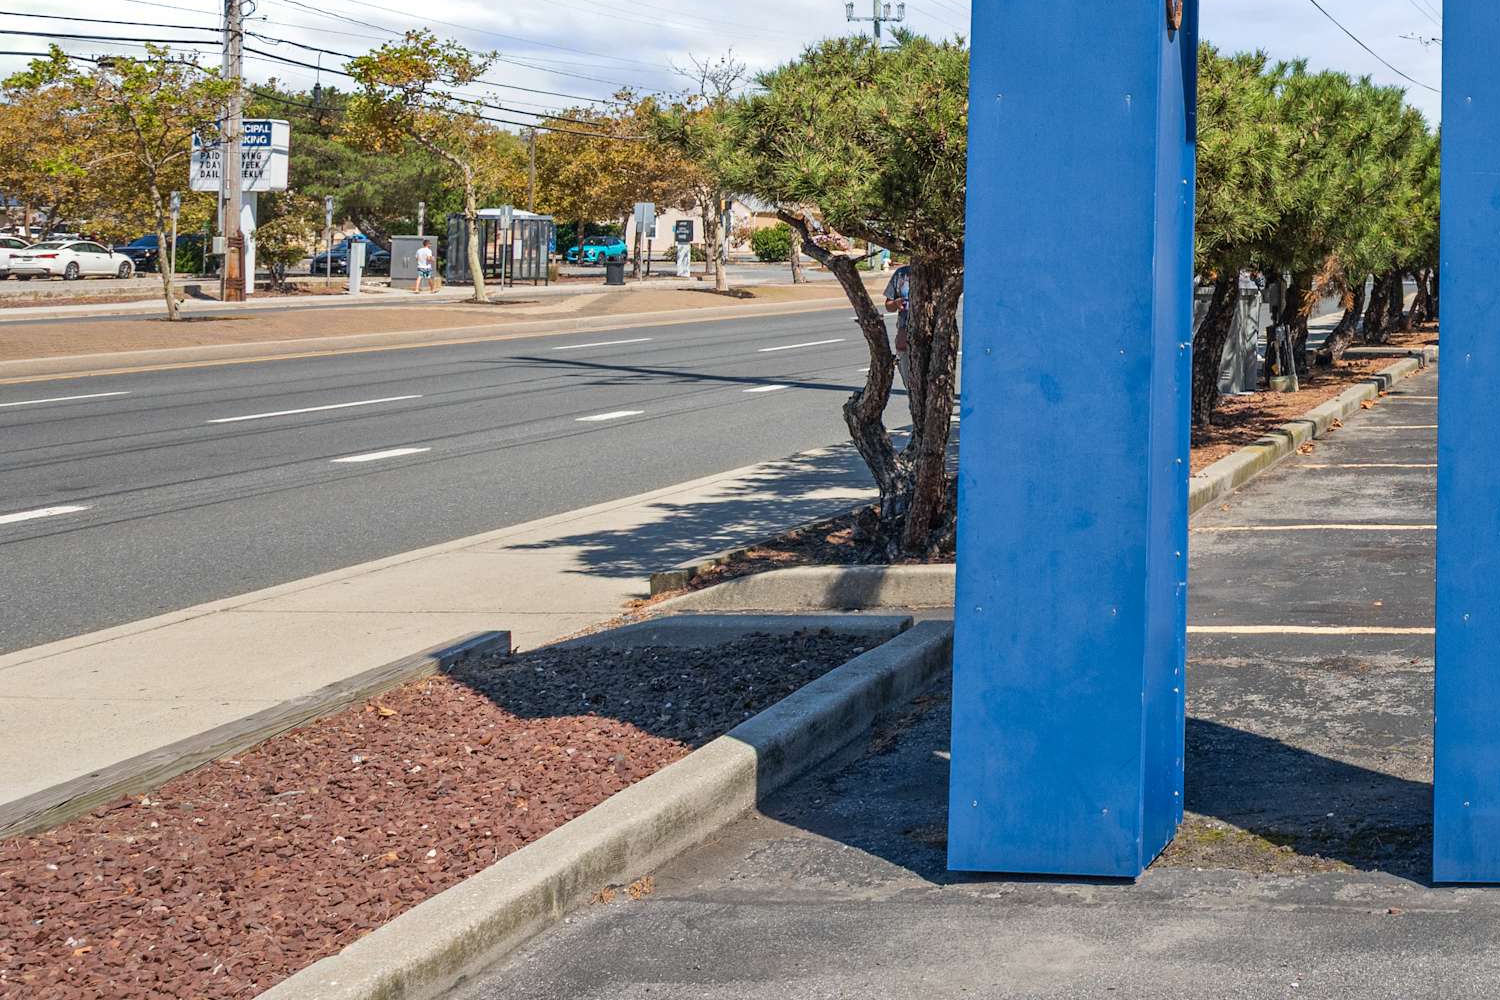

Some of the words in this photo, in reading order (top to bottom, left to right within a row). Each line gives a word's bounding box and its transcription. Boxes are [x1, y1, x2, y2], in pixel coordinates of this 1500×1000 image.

[244, 124, 271, 133] CIPAL
[243, 135, 267, 144] KING
[200, 152, 220, 160] PAID
[200, 170, 220, 178] DAIL
